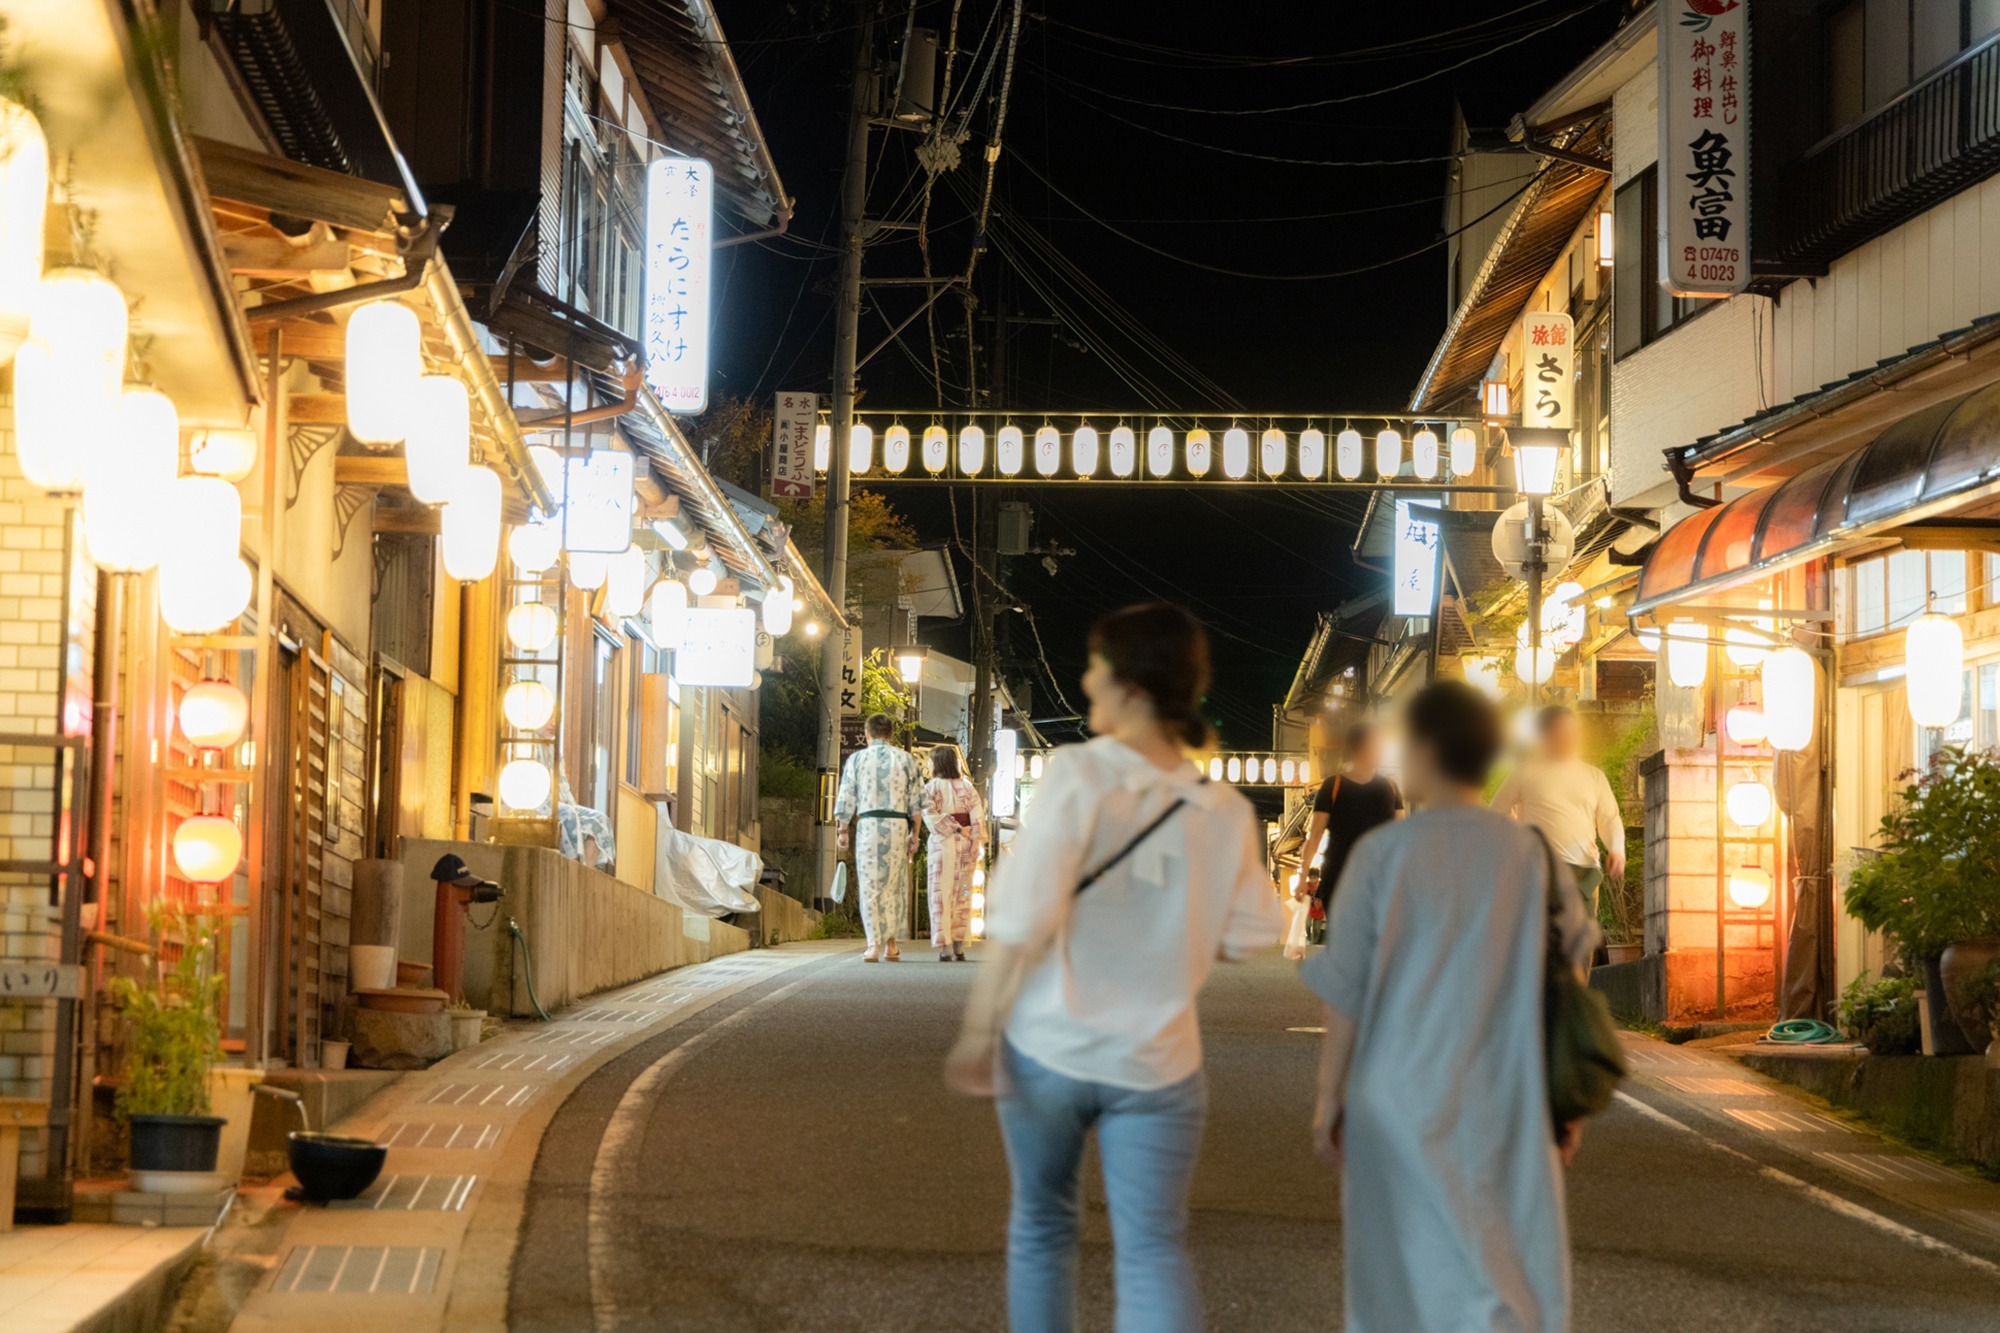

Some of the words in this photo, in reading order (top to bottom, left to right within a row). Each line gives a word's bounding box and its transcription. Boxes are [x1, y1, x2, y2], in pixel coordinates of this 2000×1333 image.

[1691, 36, 1716, 119] 御料理
[1719, 31, 1738, 125] 鮮魚・仕出し
[1686, 128, 1736, 242] 魚富
[1687, 264, 1697, 279] 4
[1700, 264, 1736, 281] 0023
[1700, 247, 1740, 262] 07476
[1531, 323, 1568, 346] 旅館
[1535, 352, 1564, 428] さら
[791, 411, 813, 480] ごまどうふ
